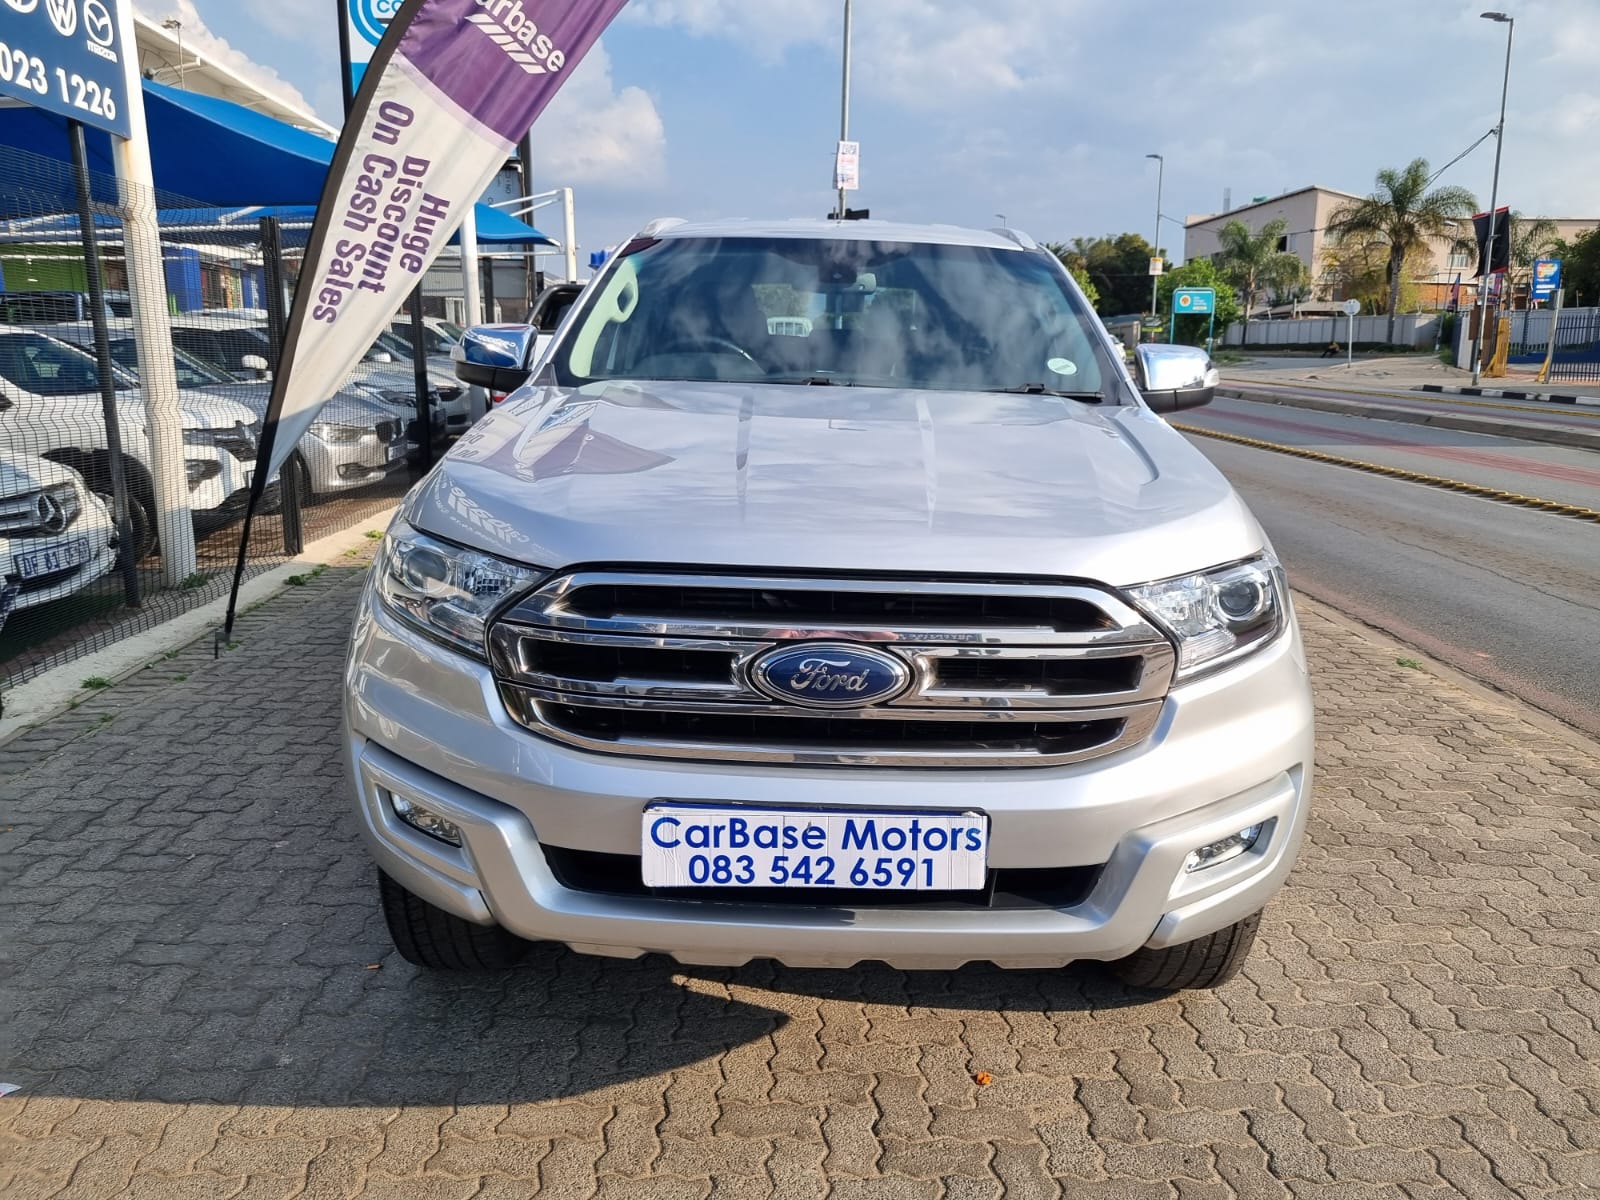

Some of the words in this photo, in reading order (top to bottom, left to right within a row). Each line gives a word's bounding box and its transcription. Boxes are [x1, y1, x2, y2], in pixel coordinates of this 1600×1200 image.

[0, 43, 48, 95] 023
[56, 67, 116, 120] 1226
[371, 101, 414, 145] On
[344, 153, 397, 233] Cash
[358, 155, 430, 294] Discount
[400, 192, 450, 274] Huge
[313, 239, 366, 324] Sales
[790, 658, 870, 692] Ford
[650, 816, 827, 850] CarBase
[841, 819, 982, 852] Motors
[688, 854, 755, 884] 083
[768, 855, 835, 885] 542
[849, 857, 933, 887] 6591
